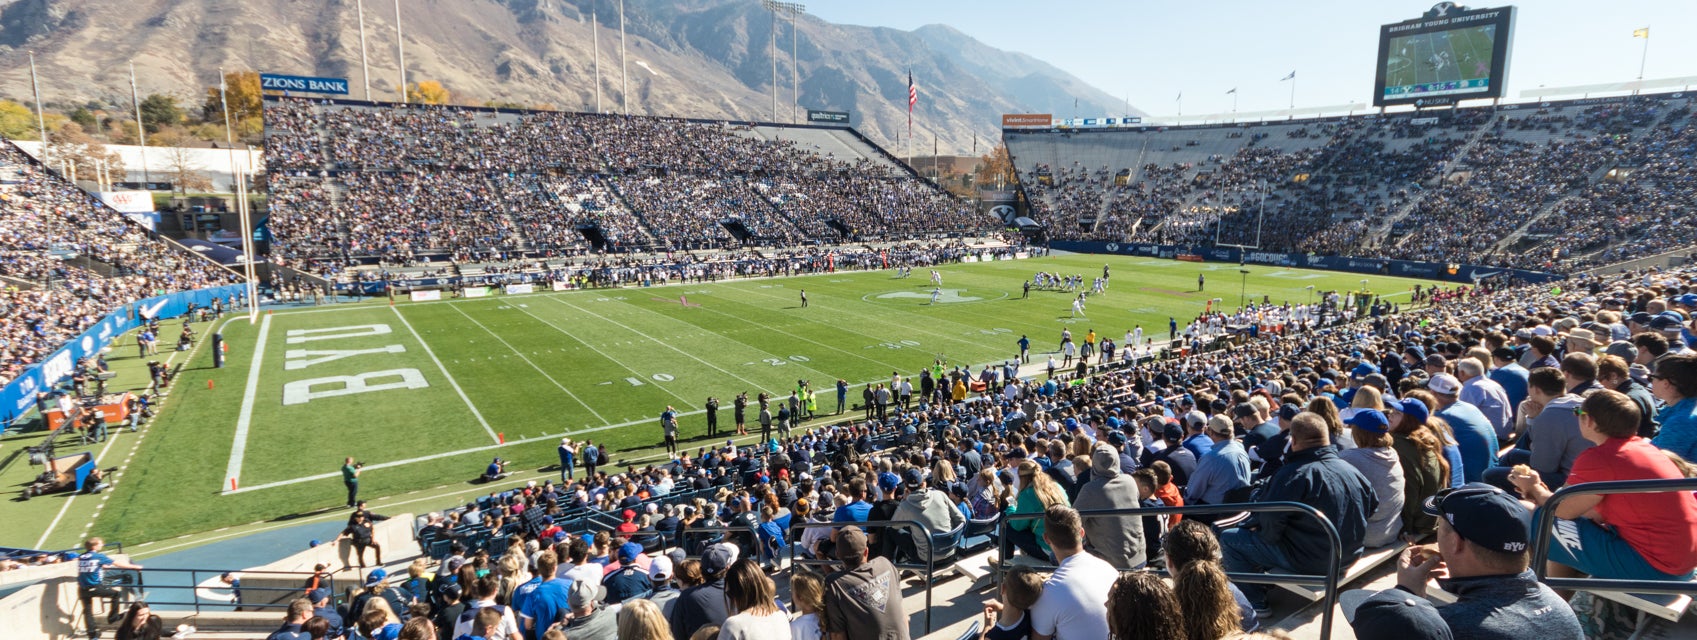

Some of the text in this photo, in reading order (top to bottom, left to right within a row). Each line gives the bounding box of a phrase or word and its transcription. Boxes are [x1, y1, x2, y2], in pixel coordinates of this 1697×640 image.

[1389, 11, 1500, 32] BRIGHAM YOUNG UNIVERSITY
[262, 76, 347, 92] ZIONS BANK
[282, 324, 430, 406] BYU
[762, 355, 810, 366] 20
[624, 373, 676, 387] 10
[1504, 541, 1526, 552] BYU
[1534, 605, 1553, 615] BYU
